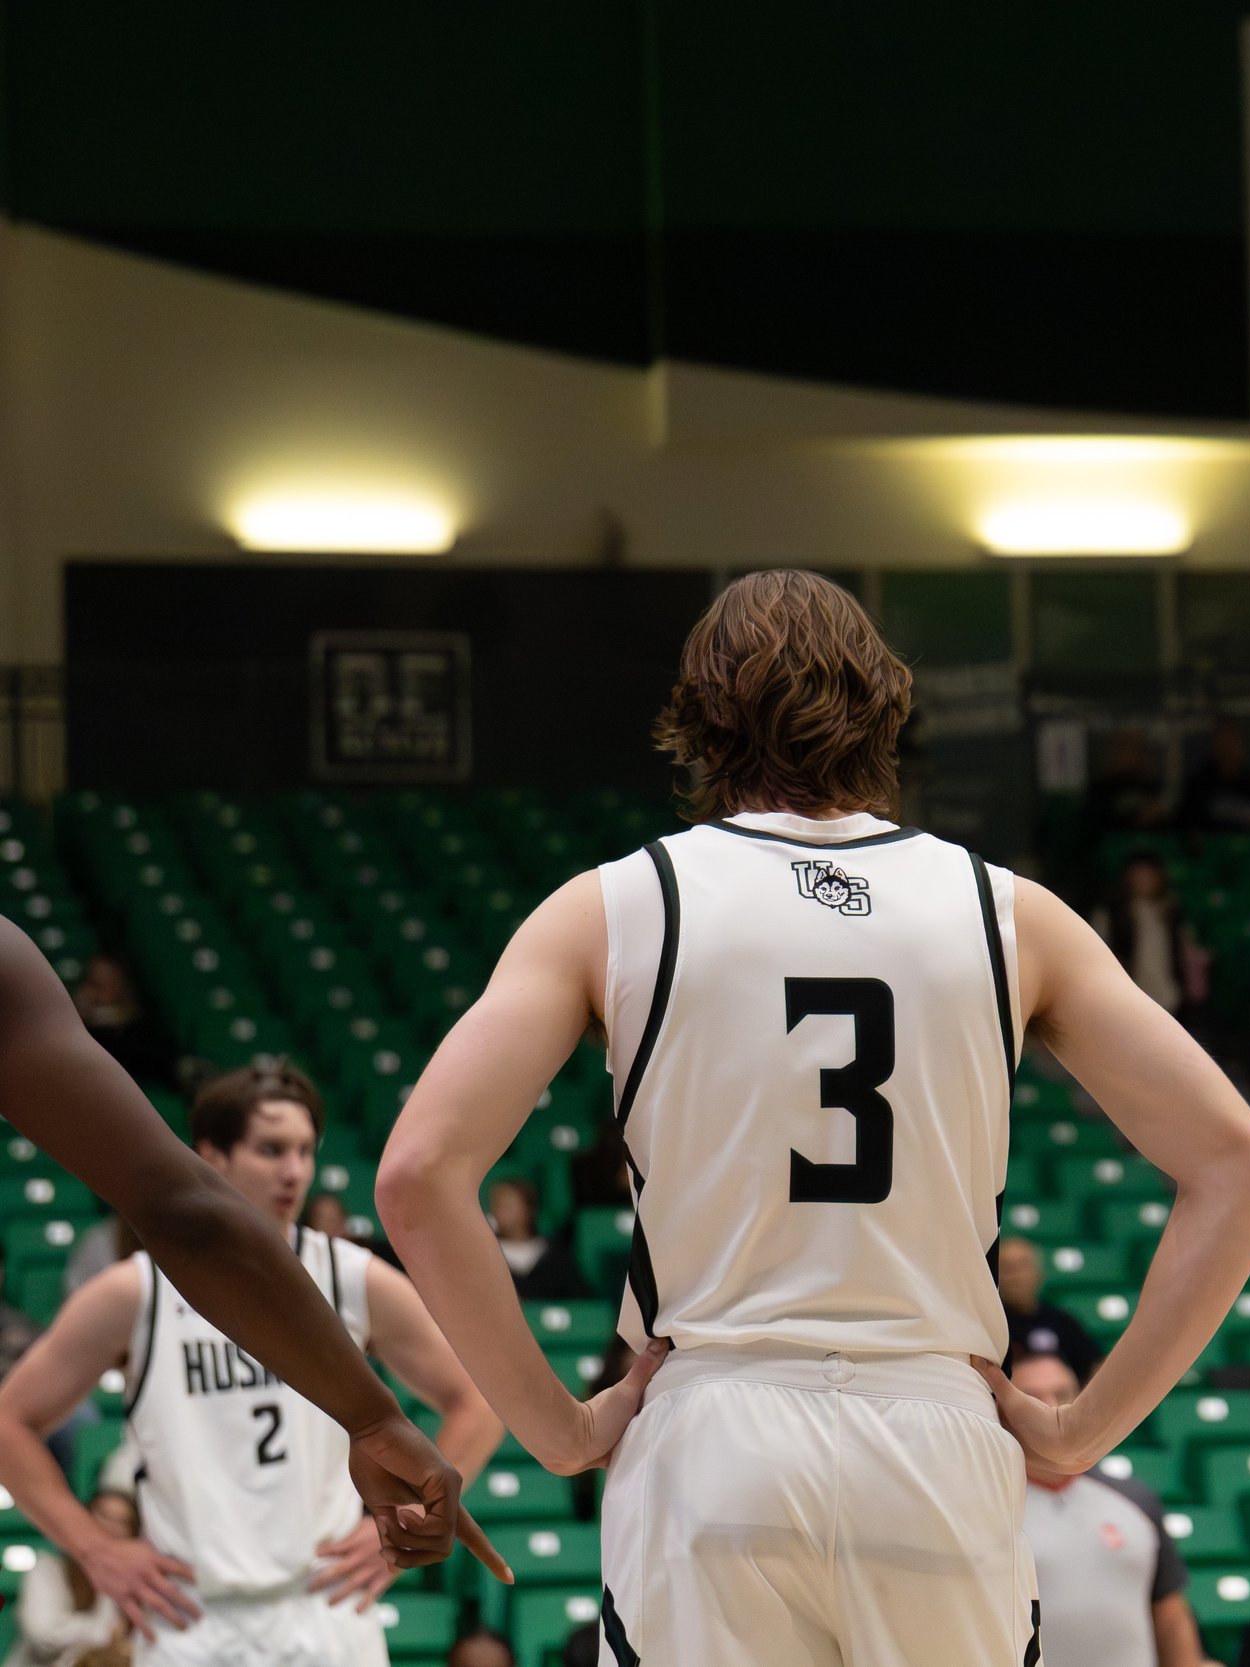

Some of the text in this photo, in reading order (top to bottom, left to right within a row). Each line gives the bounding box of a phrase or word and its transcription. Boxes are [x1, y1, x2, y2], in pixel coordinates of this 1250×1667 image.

[784, 976, 895, 1204] 3
[182, 1339, 283, 1396] HUS
[251, 1403, 288, 1467] 2
